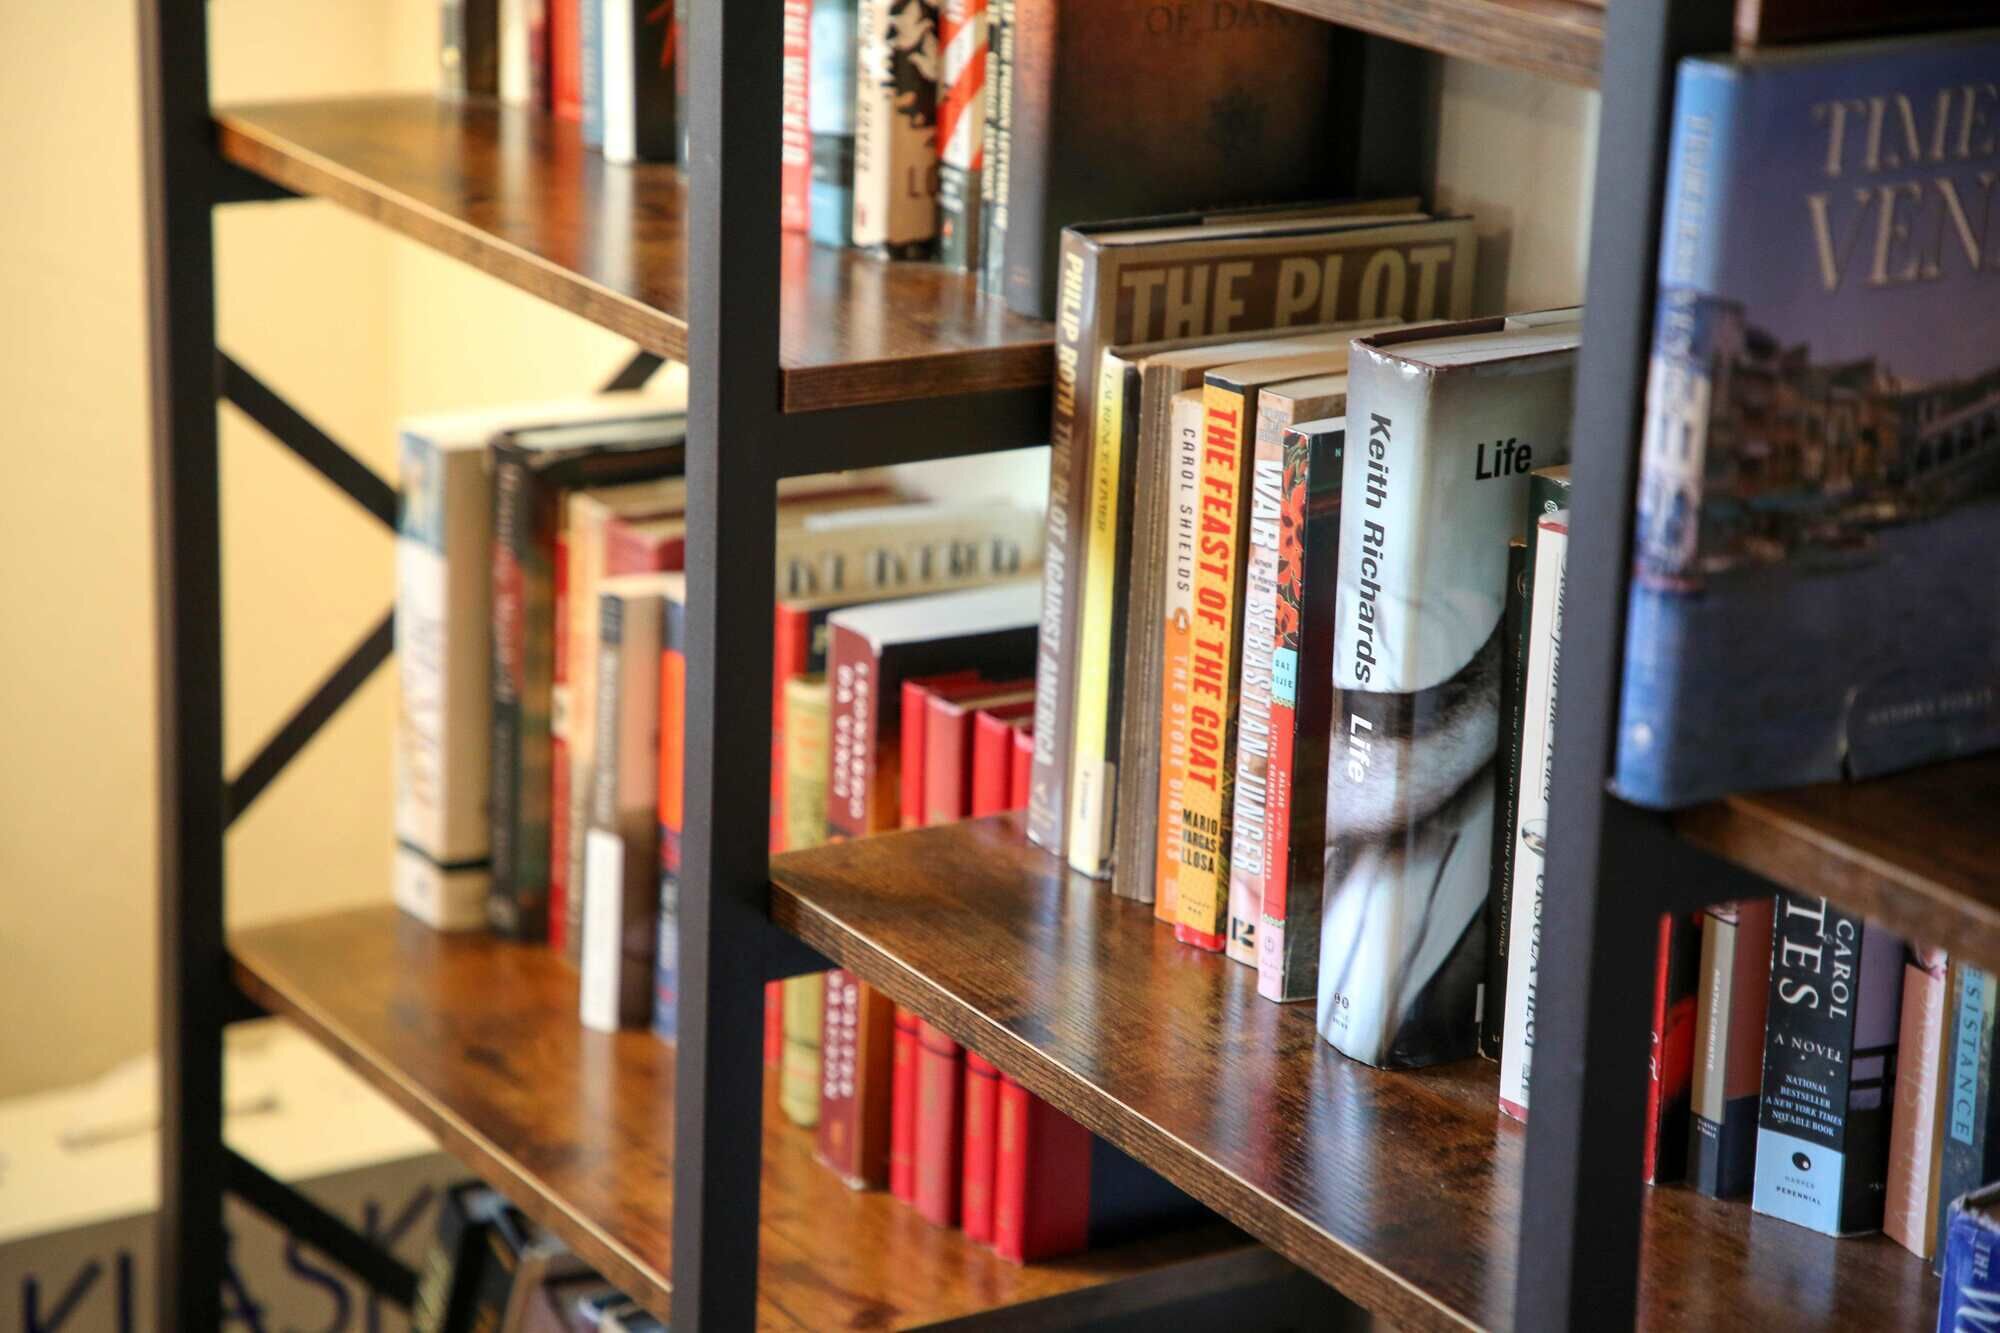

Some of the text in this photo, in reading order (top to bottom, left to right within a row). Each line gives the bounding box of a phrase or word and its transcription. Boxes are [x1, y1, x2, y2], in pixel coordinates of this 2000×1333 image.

[1060, 251, 1085, 343] PHILIP
[1121, 260, 1254, 346] THE
[1475, 437, 1533, 481] Life
[1176, 427, 1196, 592] CAROL SHIELDS
[1251, 458, 1283, 552] WAR
[1042, 541, 1067, 651] AGAINST
[1187, 408, 1237, 793] THE FEAST OF THE GOAT
[1346, 412, 1392, 784] Keith Richards Life
[1171, 655, 1189, 693] THE
[1035, 652, 1059, 766] AMERICA
[1168, 703, 1187, 770] STONE
[1233, 601, 1277, 876] SEBASTIAN JUNGER
[1166, 778, 1183, 860] DIARIES
[1182, 823, 1218, 852] VARGAS
[1183, 808, 1219, 836] MARIO
[1181, 843, 1216, 874] LLOSA
[1710, 968, 1721, 1016] AGATHA
[1828, 918, 1855, 1019] CAROL
[1774, 1032, 1843, 1064] A NOVEL
[1780, 1085, 1831, 1109] BESTSELLER
[1785, 1073, 1828, 1095] NATIONAL
[1771, 1109, 1835, 1137] NOTABLE BOOK
[1774, 1096, 1792, 1109] NEW
[1795, 1102, 1817, 1118] YORK
[1818, 1109, 1843, 1127] TIMES
[1775, 1185, 1823, 1206] PERENNIAL
[1974, 1240, 1991, 1280] THE
